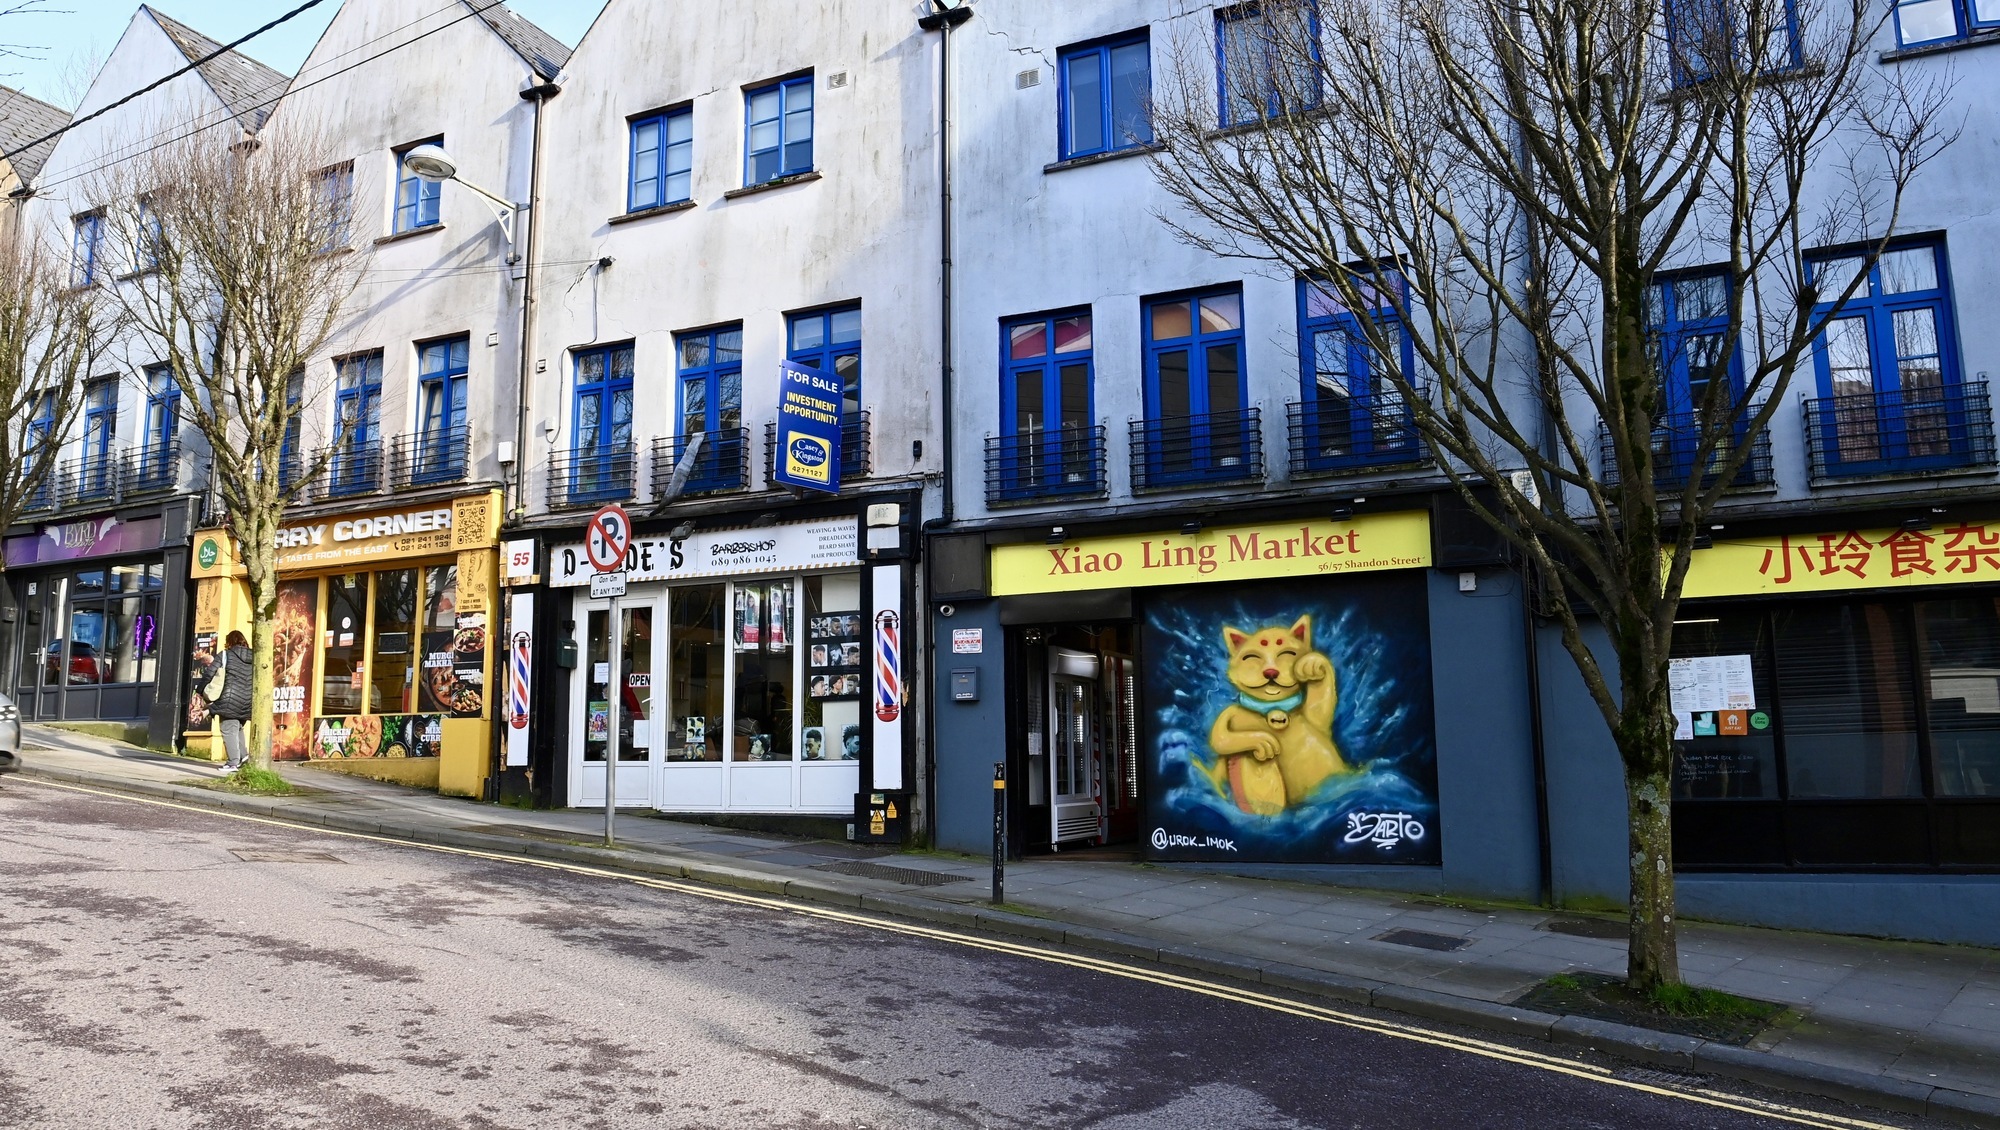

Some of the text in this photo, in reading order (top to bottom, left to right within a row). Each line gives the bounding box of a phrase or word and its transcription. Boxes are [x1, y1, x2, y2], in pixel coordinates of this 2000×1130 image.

[787, 369, 838, 393] FOR SALE
[786, 391, 837, 413] INVESTMENT
[783, 403, 838, 425] OPPORTUNITY
[796, 439, 819, 453] Casey
[792, 449, 824, 464] Kingston
[791, 465, 823, 477] 4271127
[333, 508, 452, 542] CORNER
[806, 527, 832, 535] WEAVING
[65, 521, 97, 544] BYRD
[818, 533, 856, 542] DREADLOCKS
[400, 540, 451, 552] 021 241 133
[401, 537, 415, 545] 021
[417, 535, 432, 543] 241
[838, 541, 856, 549] SHAVE
[286, 553, 313, 562] TASTE
[315, 551, 341, 560] FROM
[344, 547, 362, 556] THE
[363, 544, 389, 555] EAST
[710, 539, 776, 556] BARBERSHOP
[825, 550, 856, 558] PRODUCTS
[1048, 527, 1361, 576] Xiao Ling Market
[1758, 521, 2000, 584] 小玲食杂
[512, 552, 530, 567] 55
[711, 554, 777, 567] 089 986 1045
[1318, 556, 1422, 572] 56/57 Shandon Street
[592, 586, 624, 596] AT ANY TIME
[630, 675, 650, 686] OPEN
[273, 686, 305, 700] ONER
[273, 700, 304, 714] EBAB
[420, 734, 441, 742] CURR
